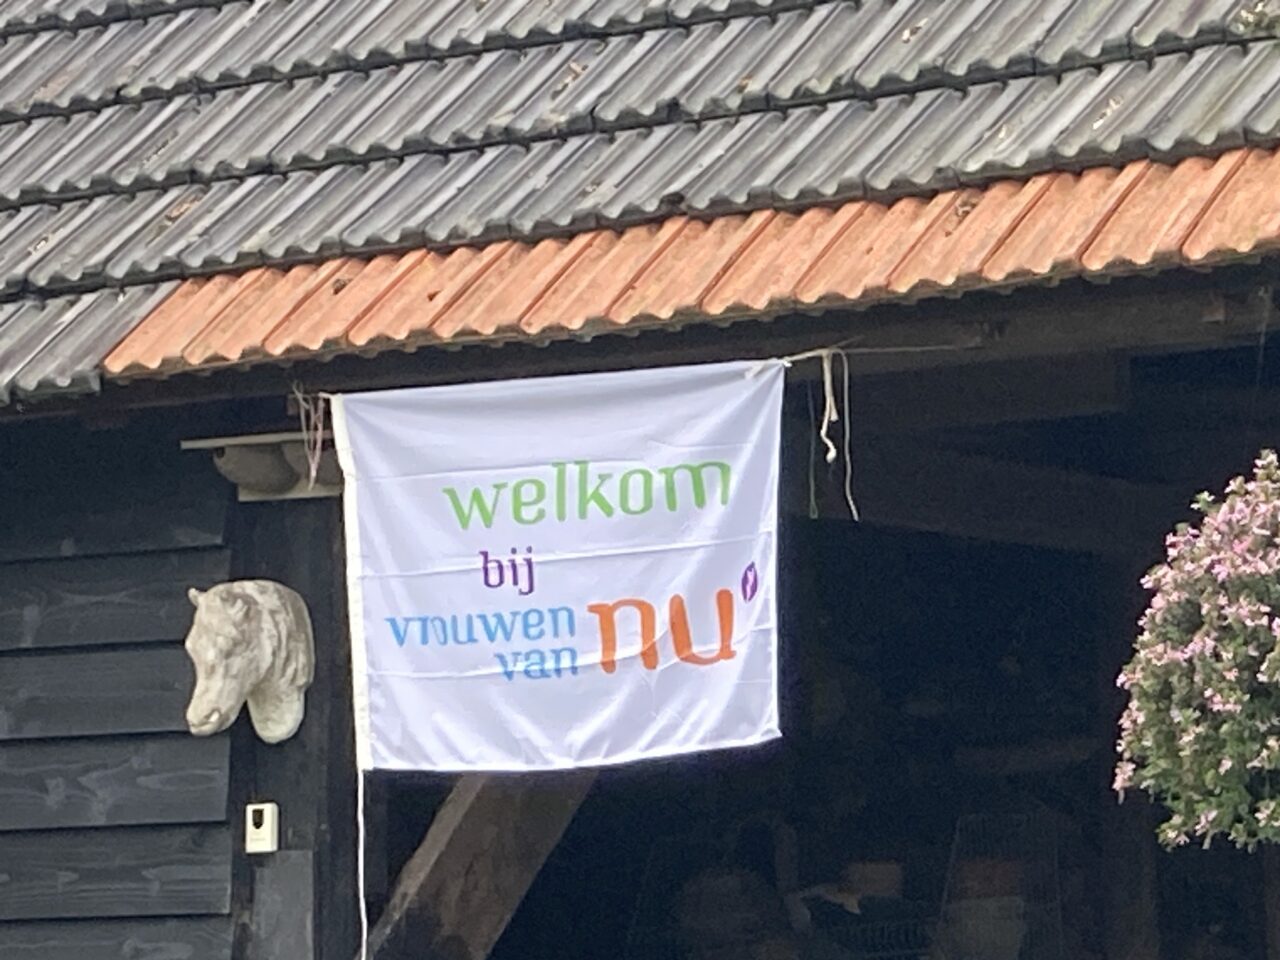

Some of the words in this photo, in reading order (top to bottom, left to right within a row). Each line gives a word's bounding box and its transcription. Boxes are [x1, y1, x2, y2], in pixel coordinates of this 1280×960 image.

[443, 460, 731, 530] welkom
[479, 545, 536, 596] bij
[494, 646, 579, 682] van
